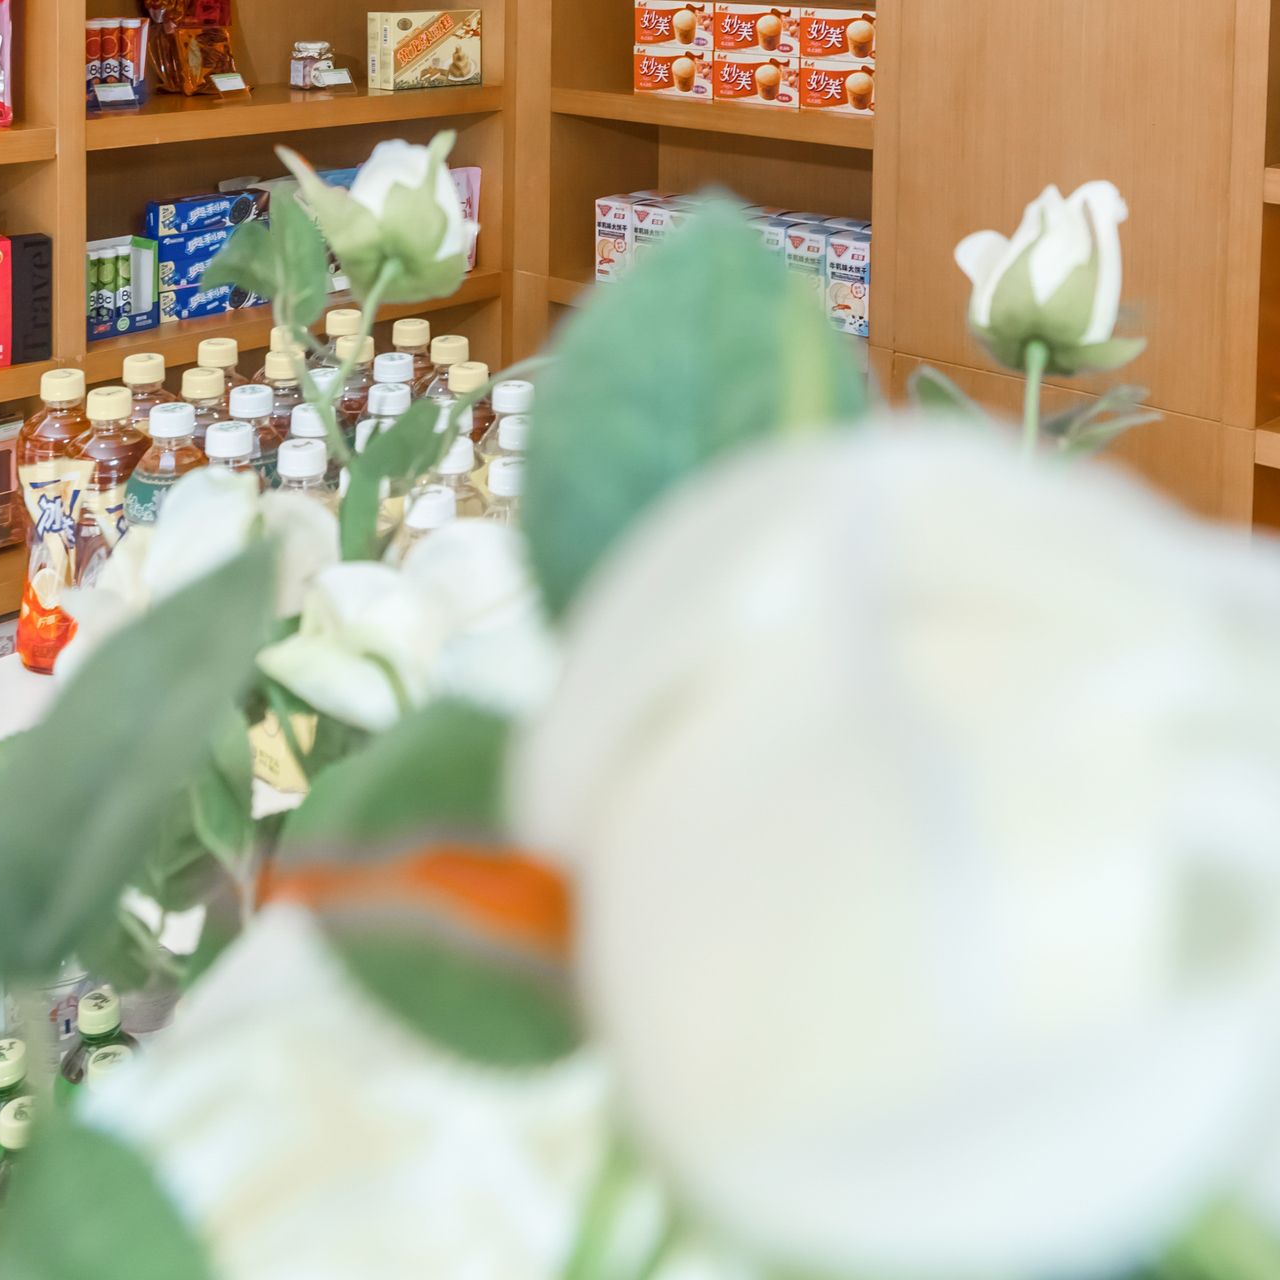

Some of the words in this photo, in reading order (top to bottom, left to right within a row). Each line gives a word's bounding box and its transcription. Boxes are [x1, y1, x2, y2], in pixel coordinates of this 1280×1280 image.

[641, 10, 671, 36] 妙芙
[720, 15, 755, 42] 妙芙
[807, 20, 845, 48] 妙芙
[639, 58, 671, 83] 妙芙
[720, 63, 754, 91] 妙芙
[807, 71, 844, 99] 妙芙
